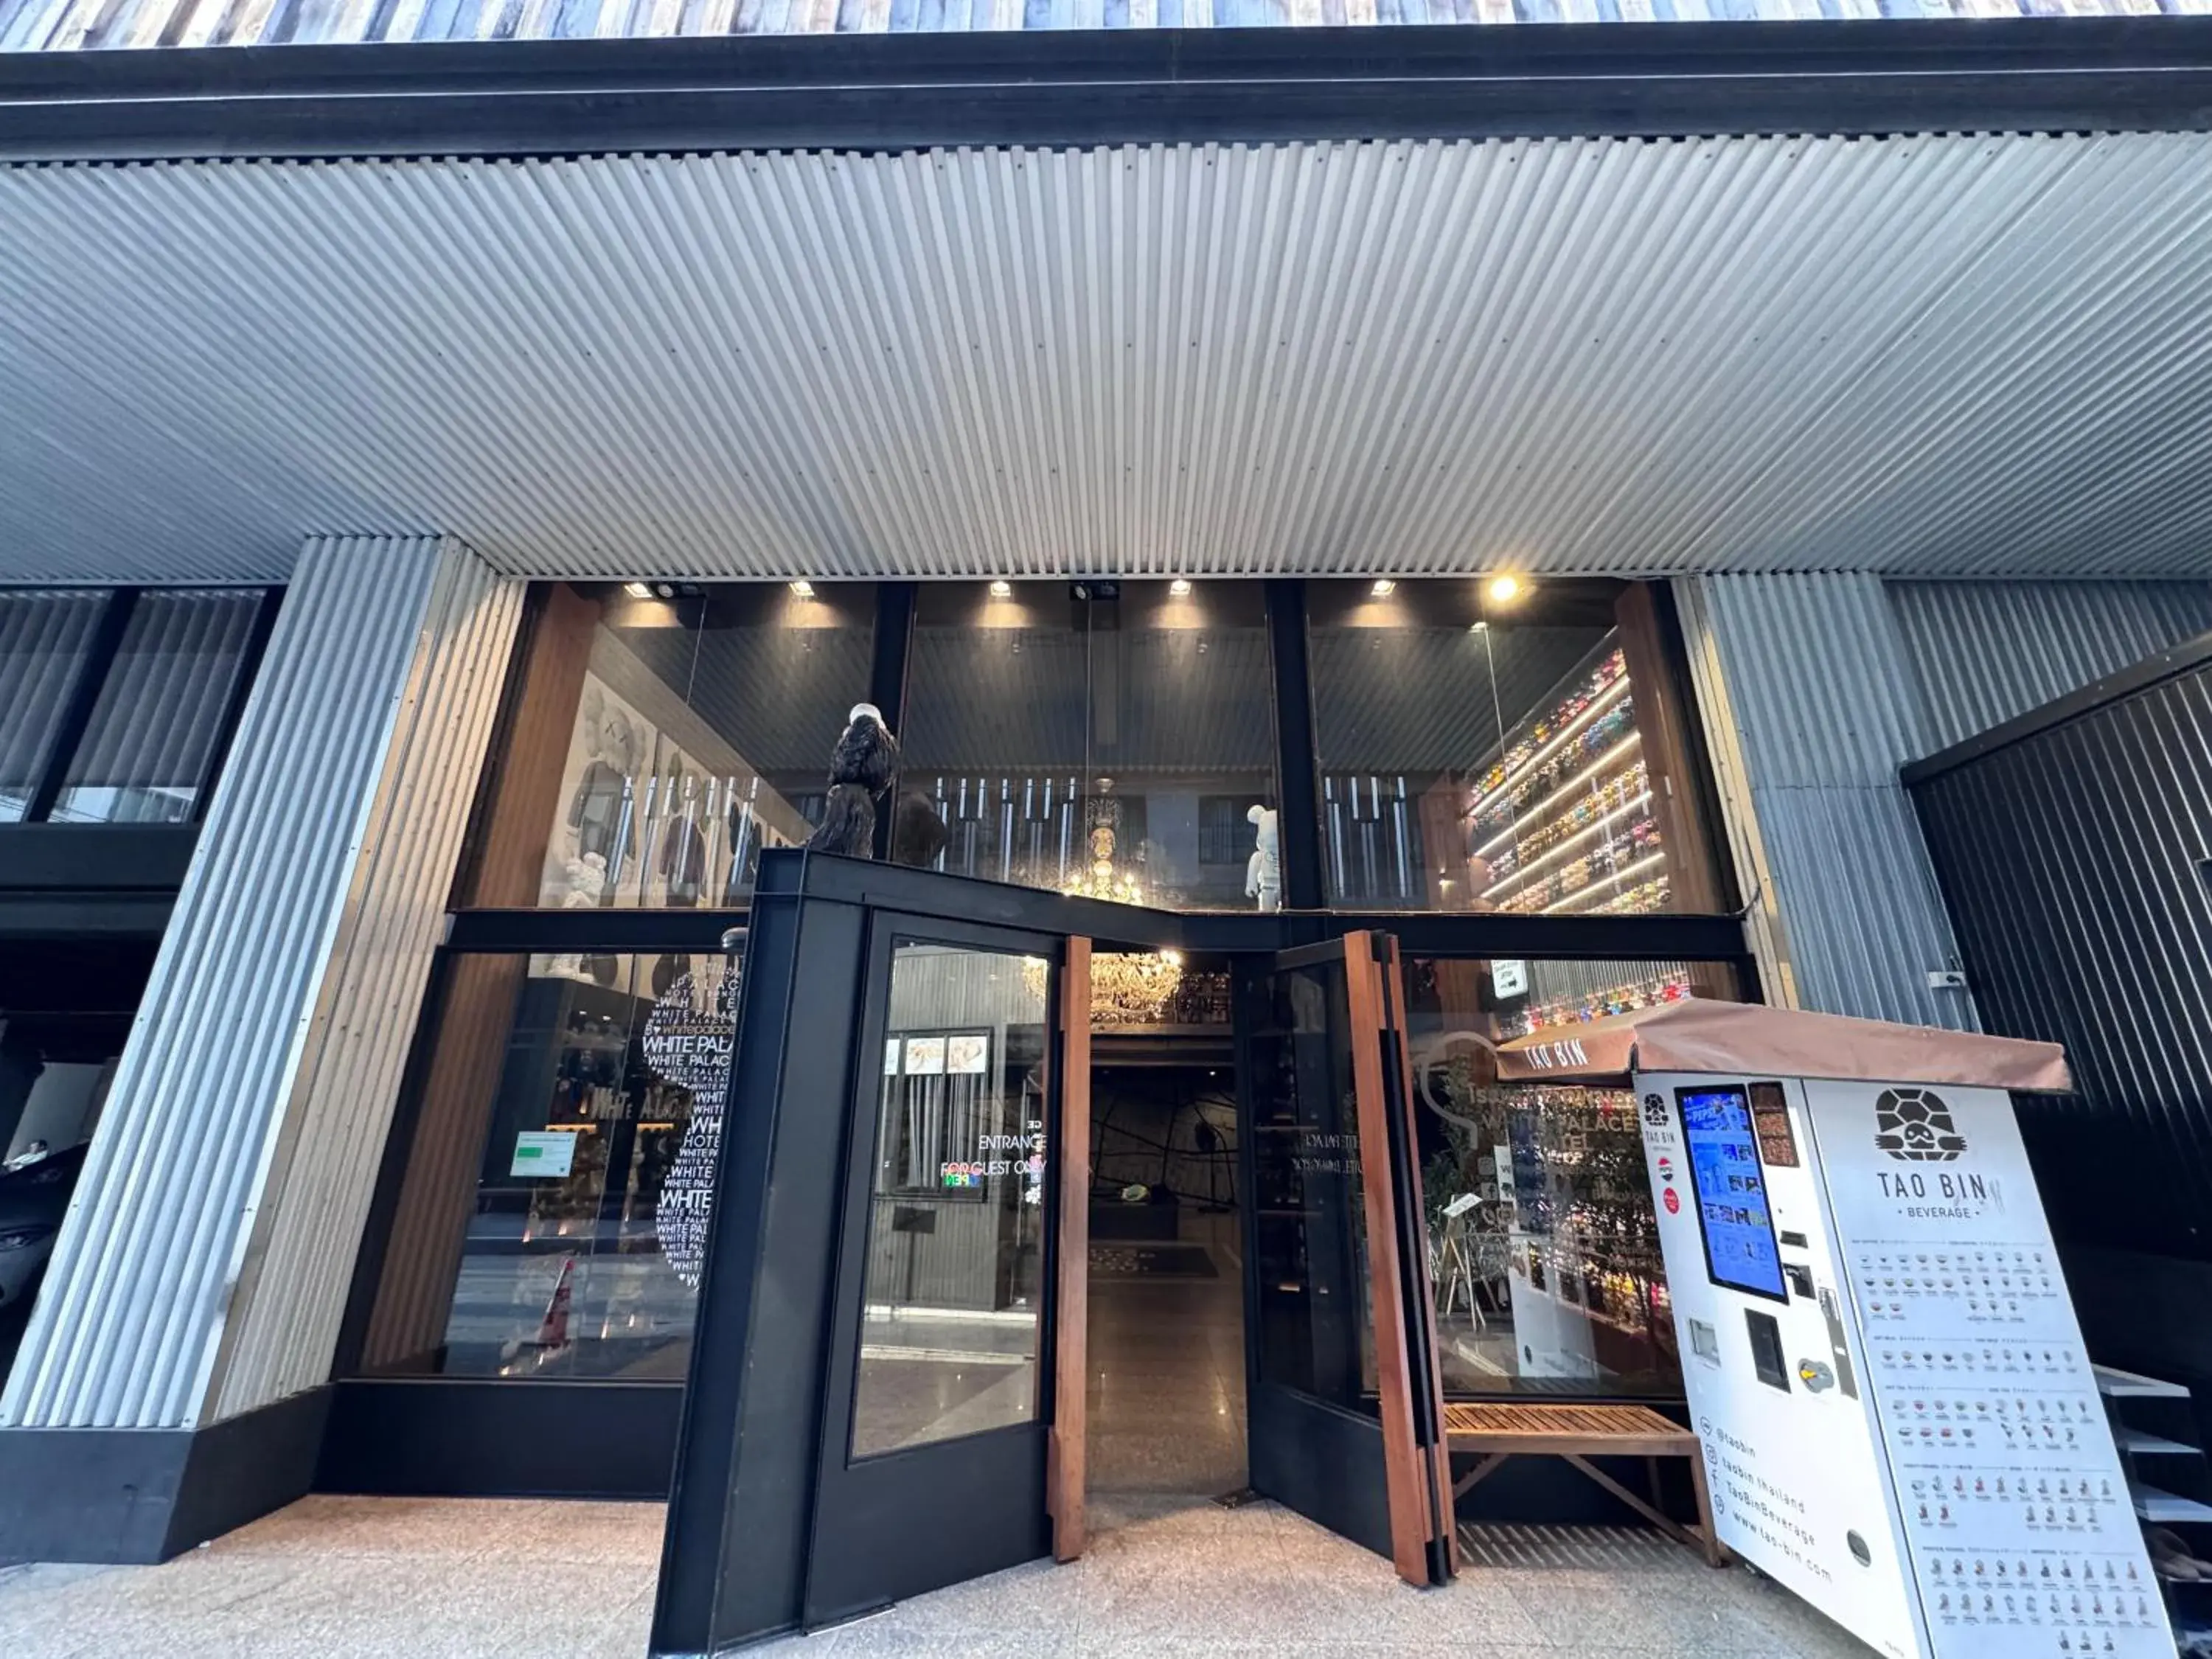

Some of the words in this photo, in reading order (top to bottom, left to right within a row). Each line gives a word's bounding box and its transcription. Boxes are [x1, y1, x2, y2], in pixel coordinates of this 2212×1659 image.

[643, 1035, 695, 1054] WHITE
[649, 1055, 684, 1066] WHITE
[689, 1055, 730, 1067] PALAC
[1523, 1043, 1552, 1071] TAO
[1554, 1037, 1590, 1068] BIN
[978, 1134, 1048, 1150] ENTRANCE
[670, 1166, 713, 1178] WHITE
[941, 1161, 970, 1178] FOR
[970, 1160, 1012, 1176] GUEST
[664, 1180, 692, 1189] WHITE
[1877, 1171, 1927, 1199] TAO
[1938, 1172, 1987, 1200] BIN
[660, 1189, 713, 1208] WHITE
[1907, 1206, 1972, 1219] BEVERAGE
[656, 1224, 689, 1234] WHITE
[658, 1234, 687, 1242] WHITE
[1733, 1510, 1833, 1585] wwwtao-bincom
